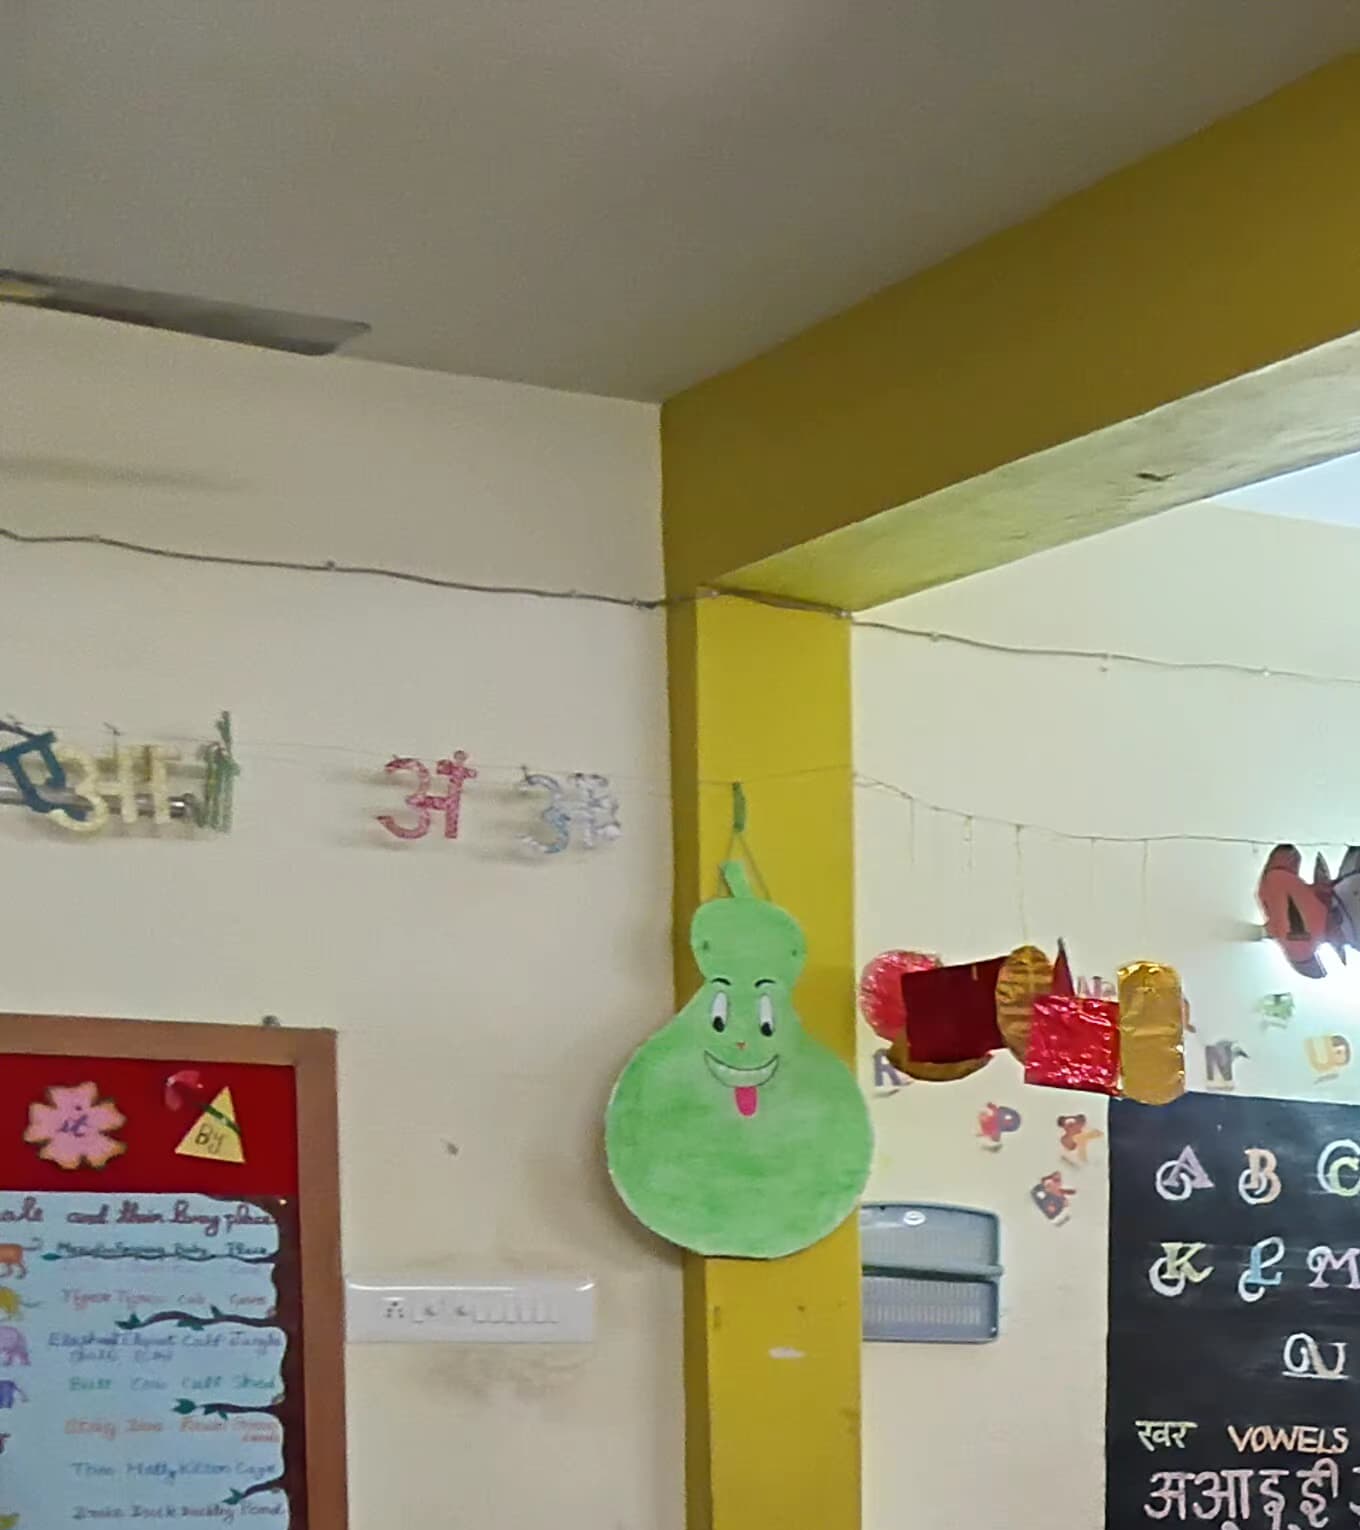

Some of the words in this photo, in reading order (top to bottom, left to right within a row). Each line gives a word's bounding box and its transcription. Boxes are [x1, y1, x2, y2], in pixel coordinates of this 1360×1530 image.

[1155, 1145, 1215, 1200] A
[1238, 1147, 1282, 1205] B
[1148, 1241, 1215, 1297] K
[1237, 1236, 1285, 1302] L
[1283, 1332, 1348, 1378] U
[1227, 1424, 1349, 1454] VOWELS
[1144, 1471, 1192, 1520] अ
[1193, 1469, 1253, 1520] आ
[1297, 1458, 1338, 1528] ई
